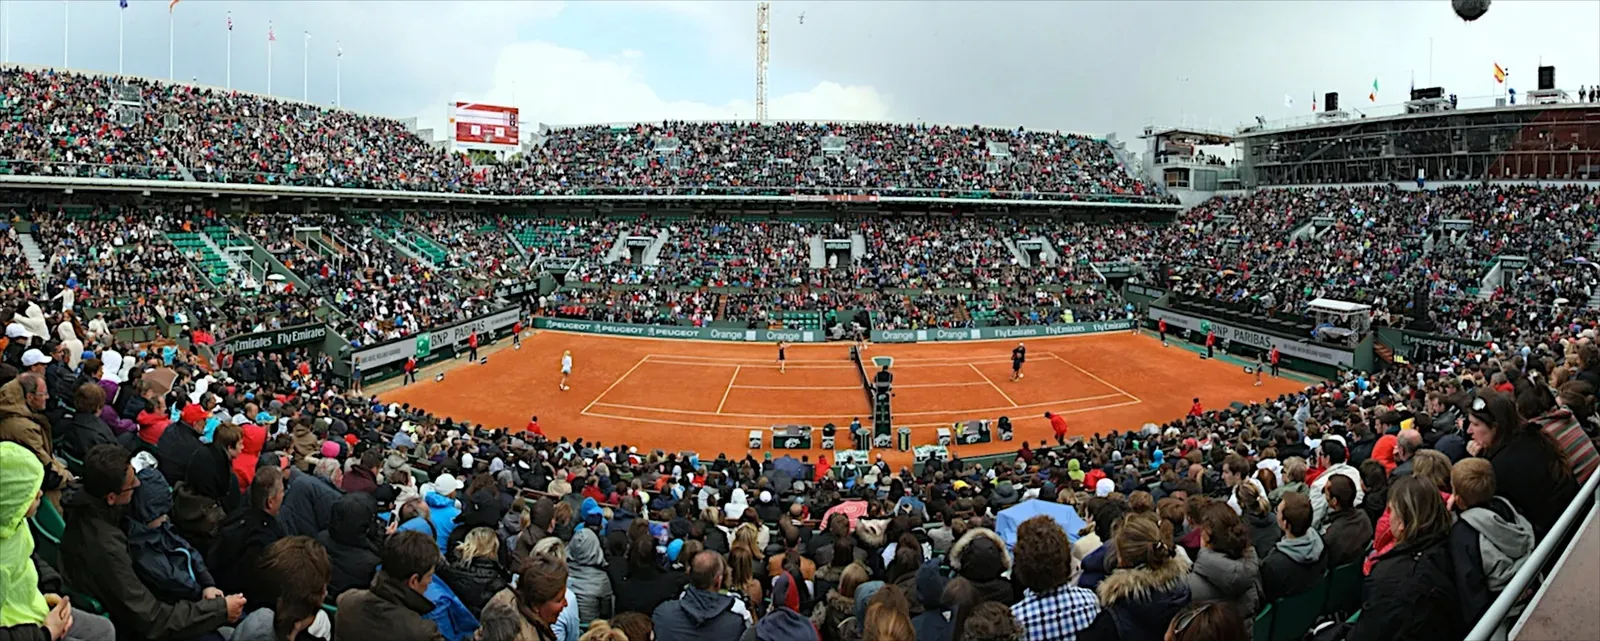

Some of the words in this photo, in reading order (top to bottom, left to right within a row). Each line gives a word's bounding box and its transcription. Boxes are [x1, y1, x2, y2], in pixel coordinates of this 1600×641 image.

[552, 321, 591, 330] PEUGEOT
[602, 325, 644, 334] PEUGEOT
[1057, 325, 1085, 334] Emirates
[1104, 321, 1131, 330] Emirates
[278, 333, 292, 345] Fly
[292, 327, 326, 341] Emirates
[656, 329, 700, 337] PEUGEOT
[711, 329, 743, 340] Orange
[767, 331, 800, 341] Orange
[882, 331, 914, 340] Orange
[937, 329, 968, 339] Orange
[1007, 328, 1037, 336] Emirates
[1211, 324, 1229, 336] BNP
[1234, 329, 1271, 348] PARIBAS
[235, 336, 272, 352] Emirates
[431, 332, 449, 347] BNP
